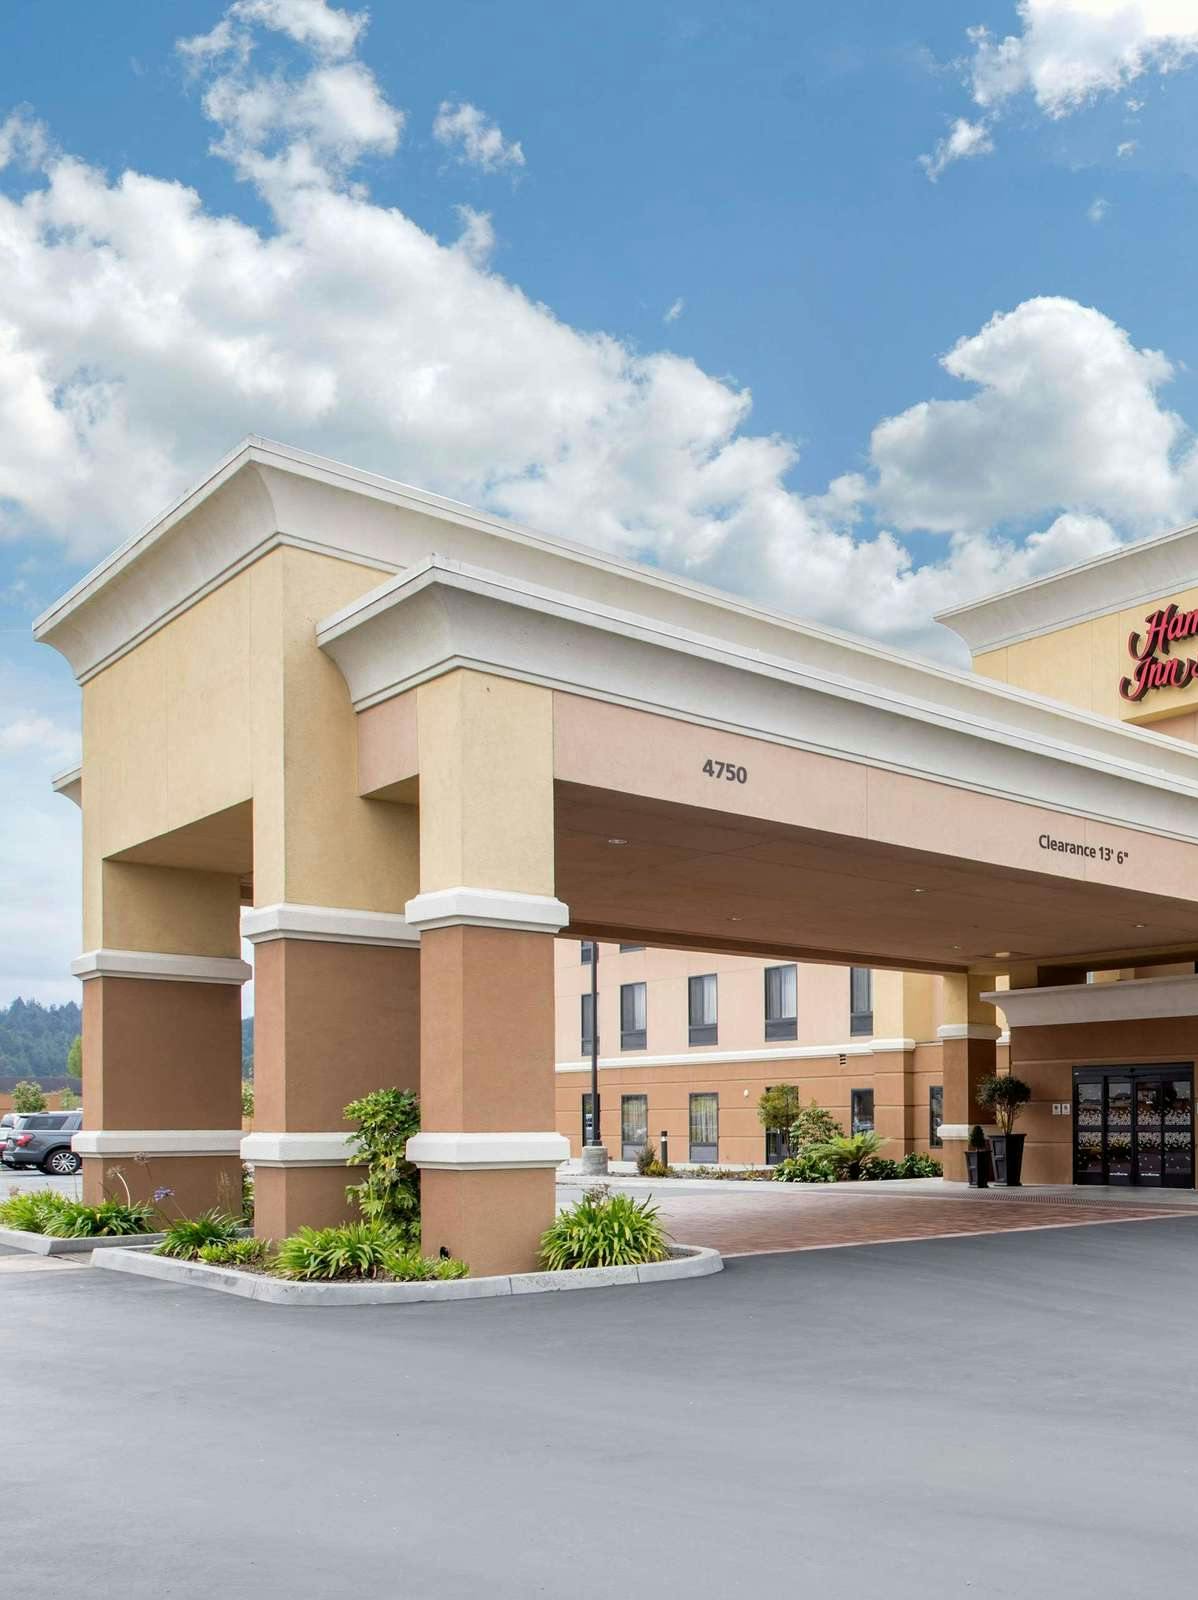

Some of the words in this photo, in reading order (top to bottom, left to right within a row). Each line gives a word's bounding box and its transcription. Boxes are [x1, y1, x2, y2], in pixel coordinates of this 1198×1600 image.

[1119, 656, 1193, 702] Inn
[702, 759, 747, 784] 4750
[1038, 834, 1096, 858] Clearance
[1098, 846, 1114, 861] 13'
